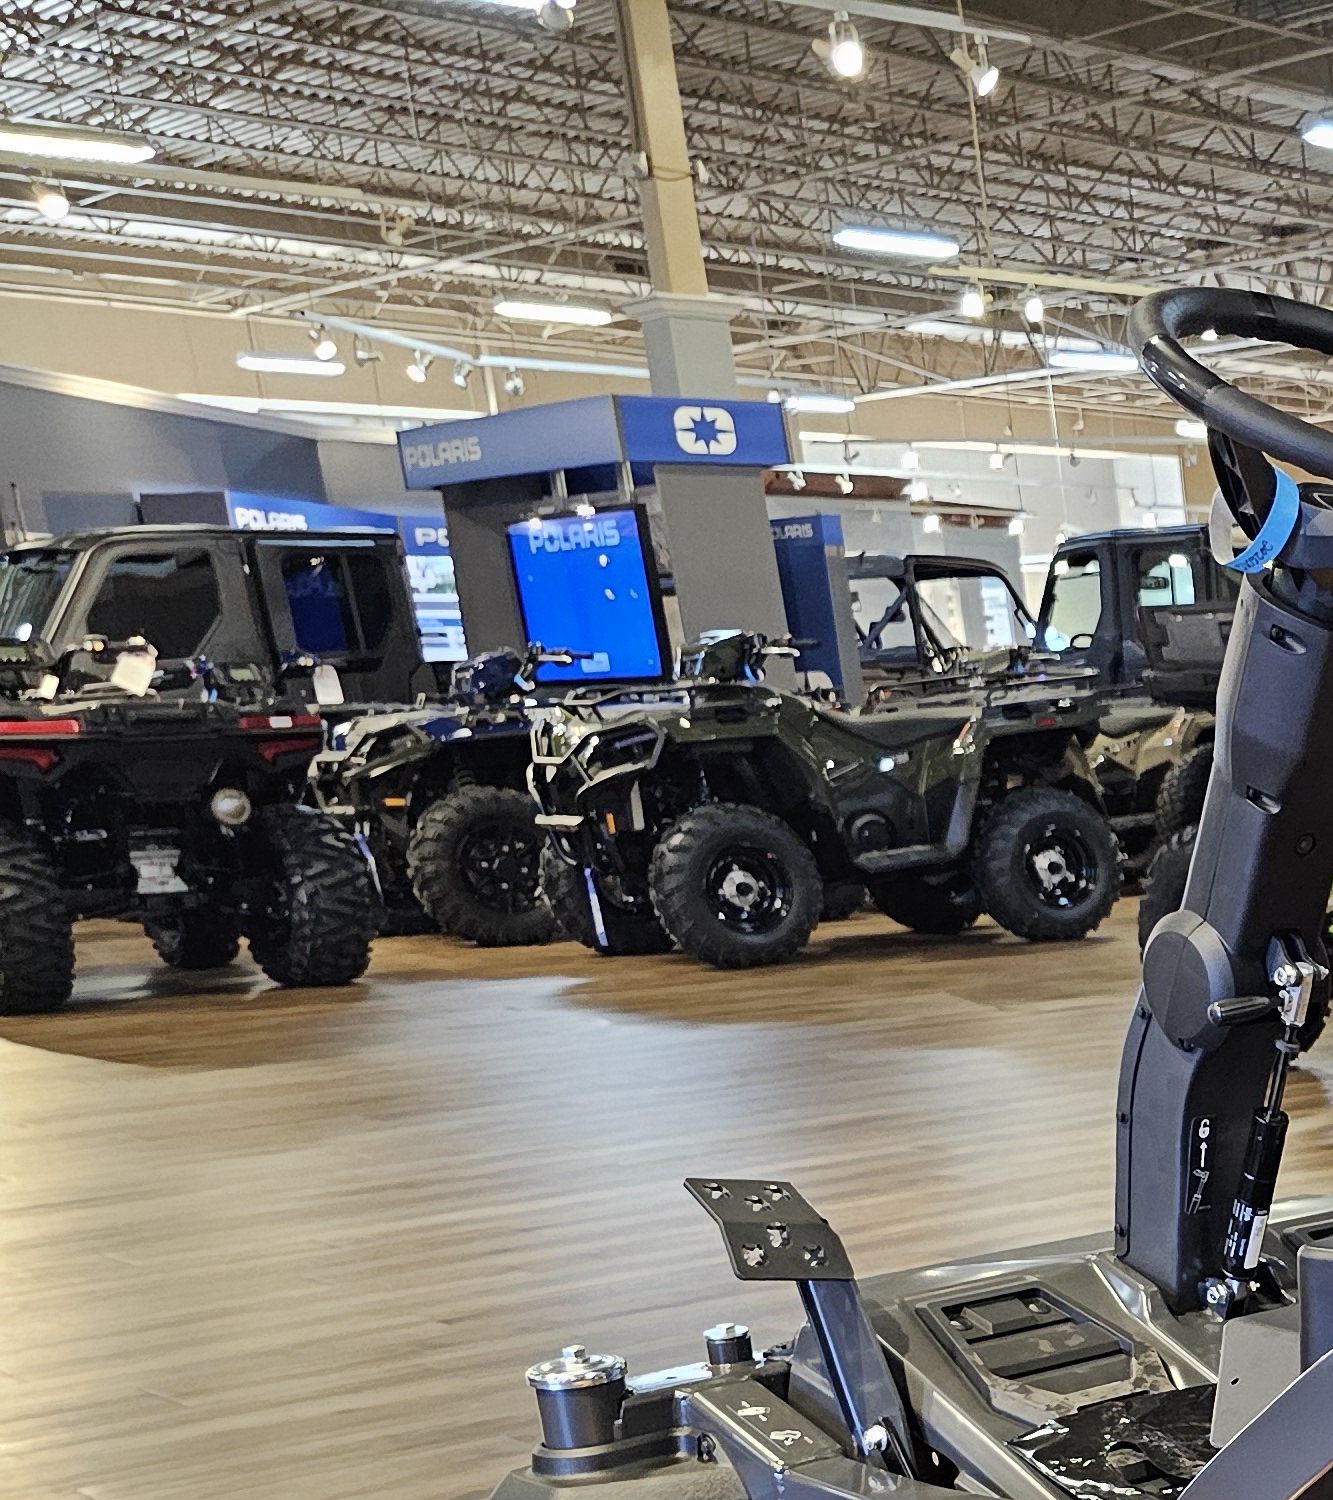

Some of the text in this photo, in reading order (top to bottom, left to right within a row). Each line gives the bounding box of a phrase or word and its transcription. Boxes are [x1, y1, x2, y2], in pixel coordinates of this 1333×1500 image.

[404, 435, 483, 471] POLARIS
[234, 507, 309, 531] POLARIS
[528, 519, 621, 554] POLARIS
